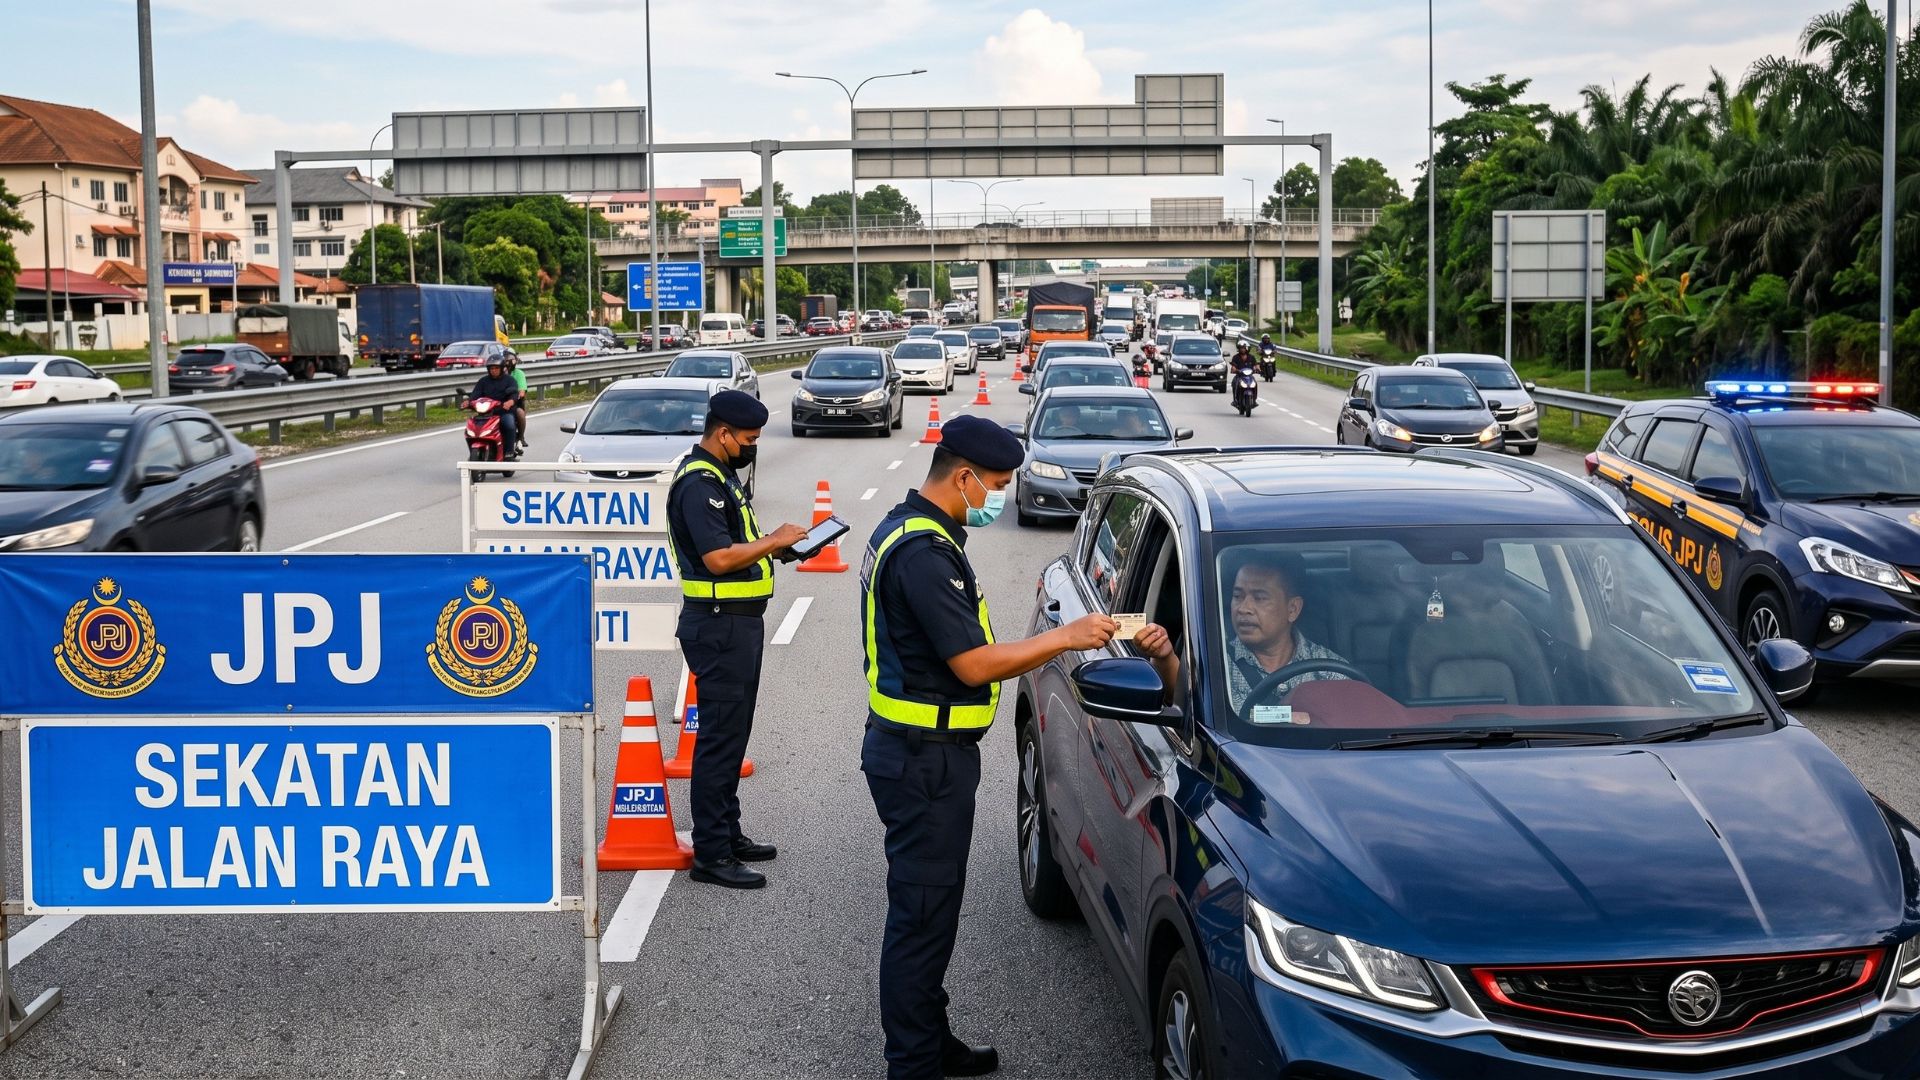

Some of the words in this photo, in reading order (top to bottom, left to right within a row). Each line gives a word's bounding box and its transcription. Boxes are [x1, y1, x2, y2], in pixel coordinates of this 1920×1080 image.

[503, 490, 649, 526] SEKATAN
[1627, 512, 1672, 555] OIS
[1675, 536, 1704, 575] JPJ
[594, 546, 673, 580] RAYA
[91, 623, 126, 651] JPJ
[211, 593, 381, 685] JPJ
[463, 622, 499, 650] JPJ
[135, 742, 450, 809] SEKATAN
[623, 788, 655, 802] JPJ
[84, 826, 296, 890] JALAN
[323, 825, 490, 888] RAYA
